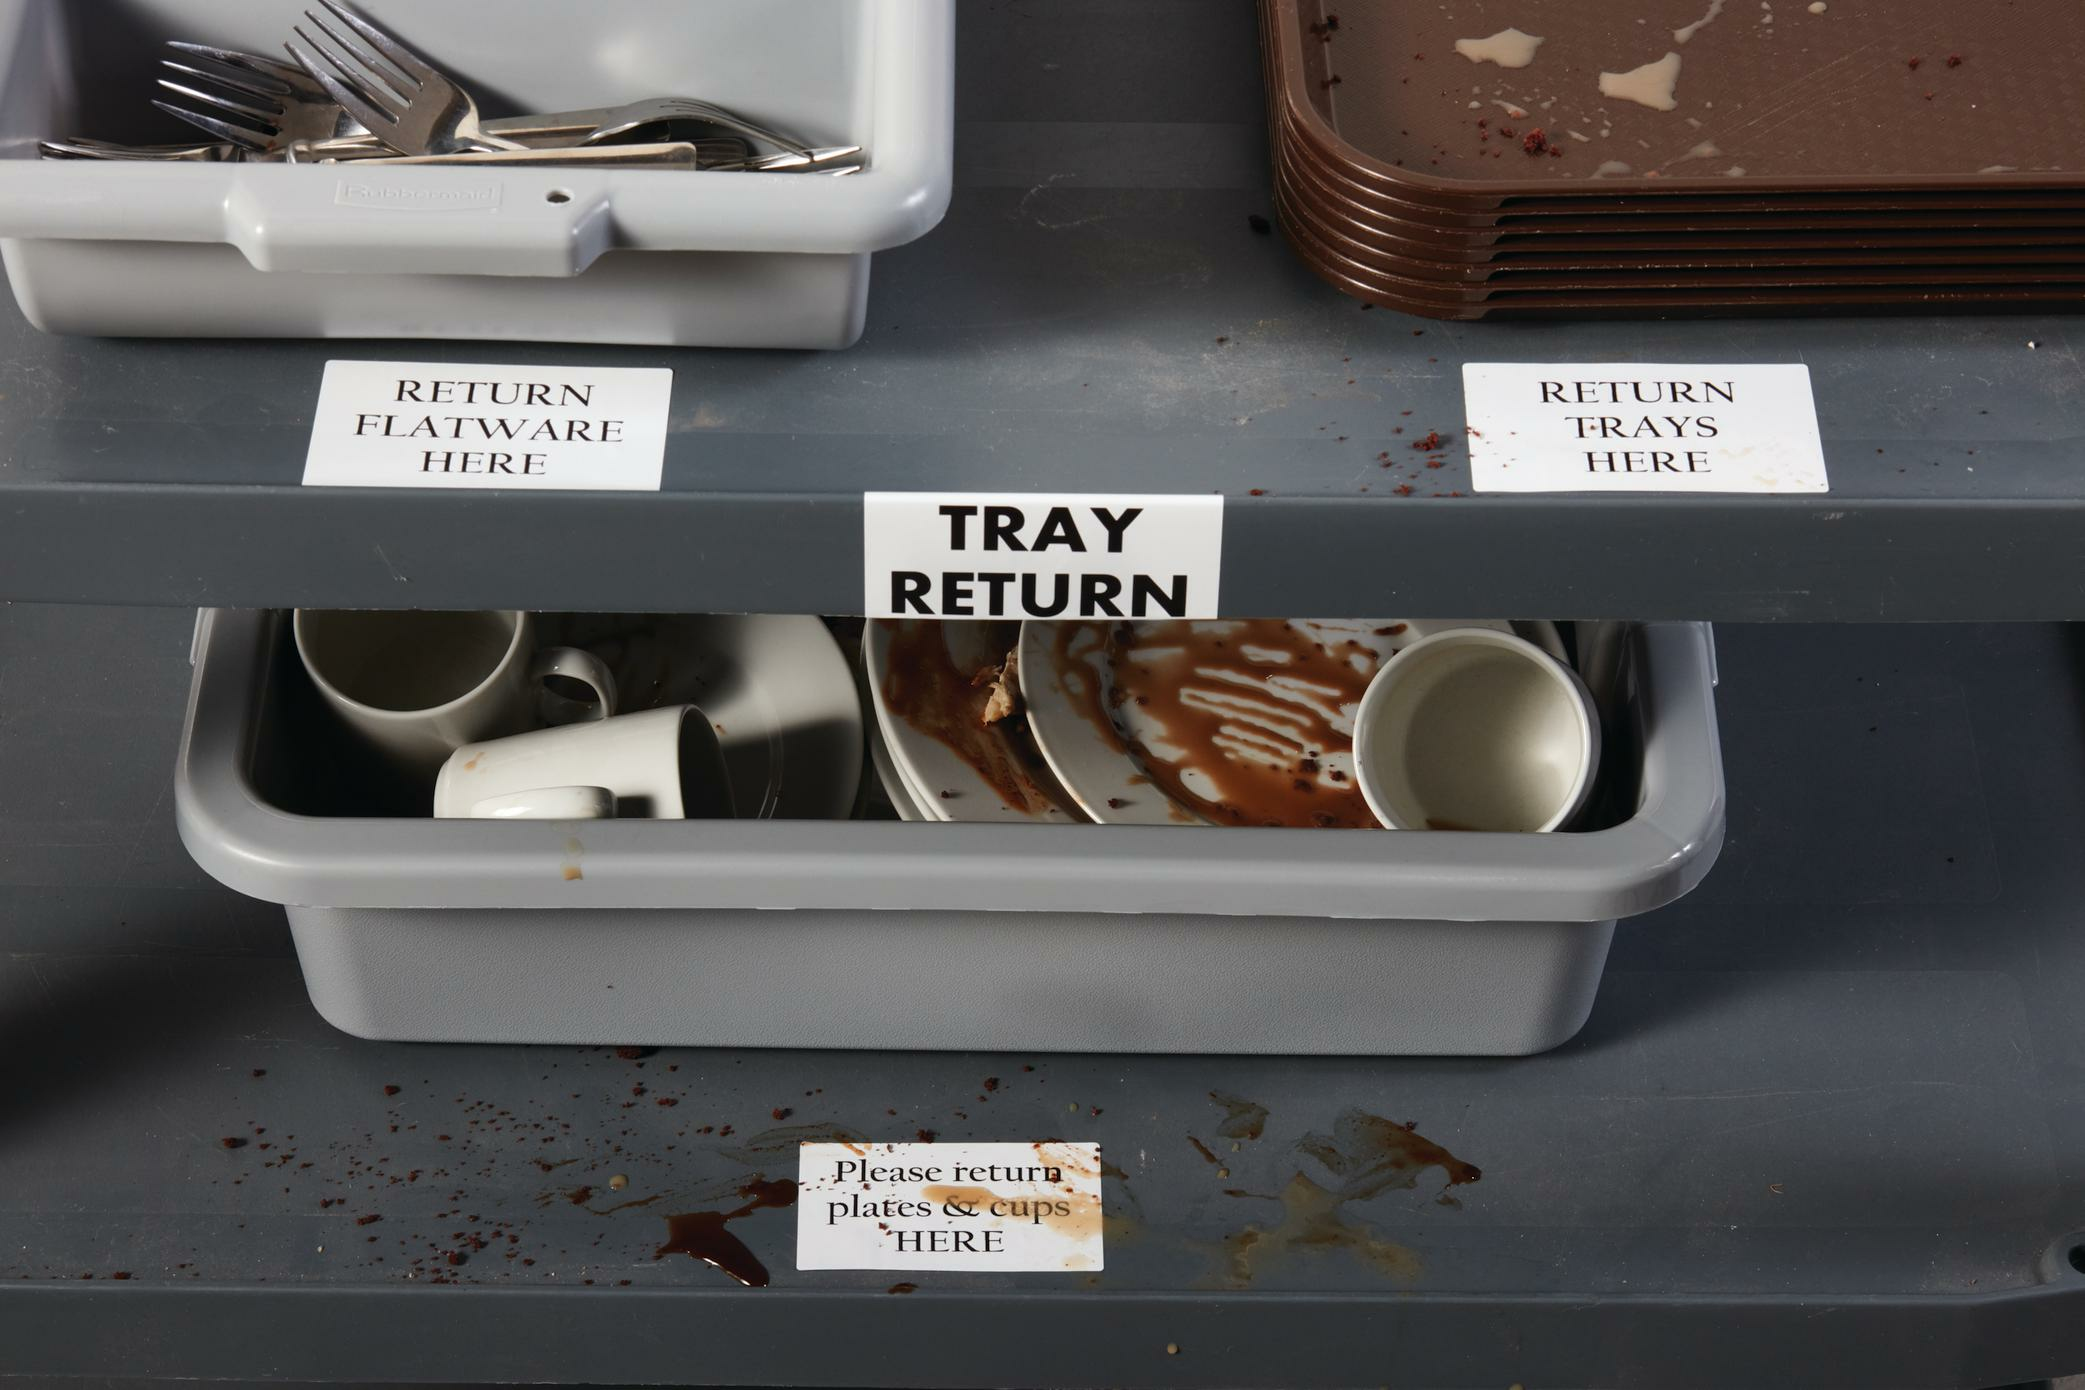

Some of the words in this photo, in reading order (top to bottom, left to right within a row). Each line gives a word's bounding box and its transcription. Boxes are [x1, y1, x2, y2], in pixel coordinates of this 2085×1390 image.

[394, 379, 596, 407] RETURN
[1538, 381, 1736, 404] RETURN
[353, 414, 625, 443] FLATWARE
[1565, 415, 1719, 439] TRAYS
[419, 450, 548, 476] HERE
[1584, 450, 1712, 473] HERE
[938, 504, 1144, 554] TRAY
[890, 570, 1188, 618] RETURN
[834, 1158, 942, 1183] Please
[953, 1162, 1063, 1183] return
[827, 1193, 932, 1226] plates
[942, 1196, 979, 1218] &
[989, 1200, 1071, 1225] cups
[895, 1229, 1005, 1253] HERE
